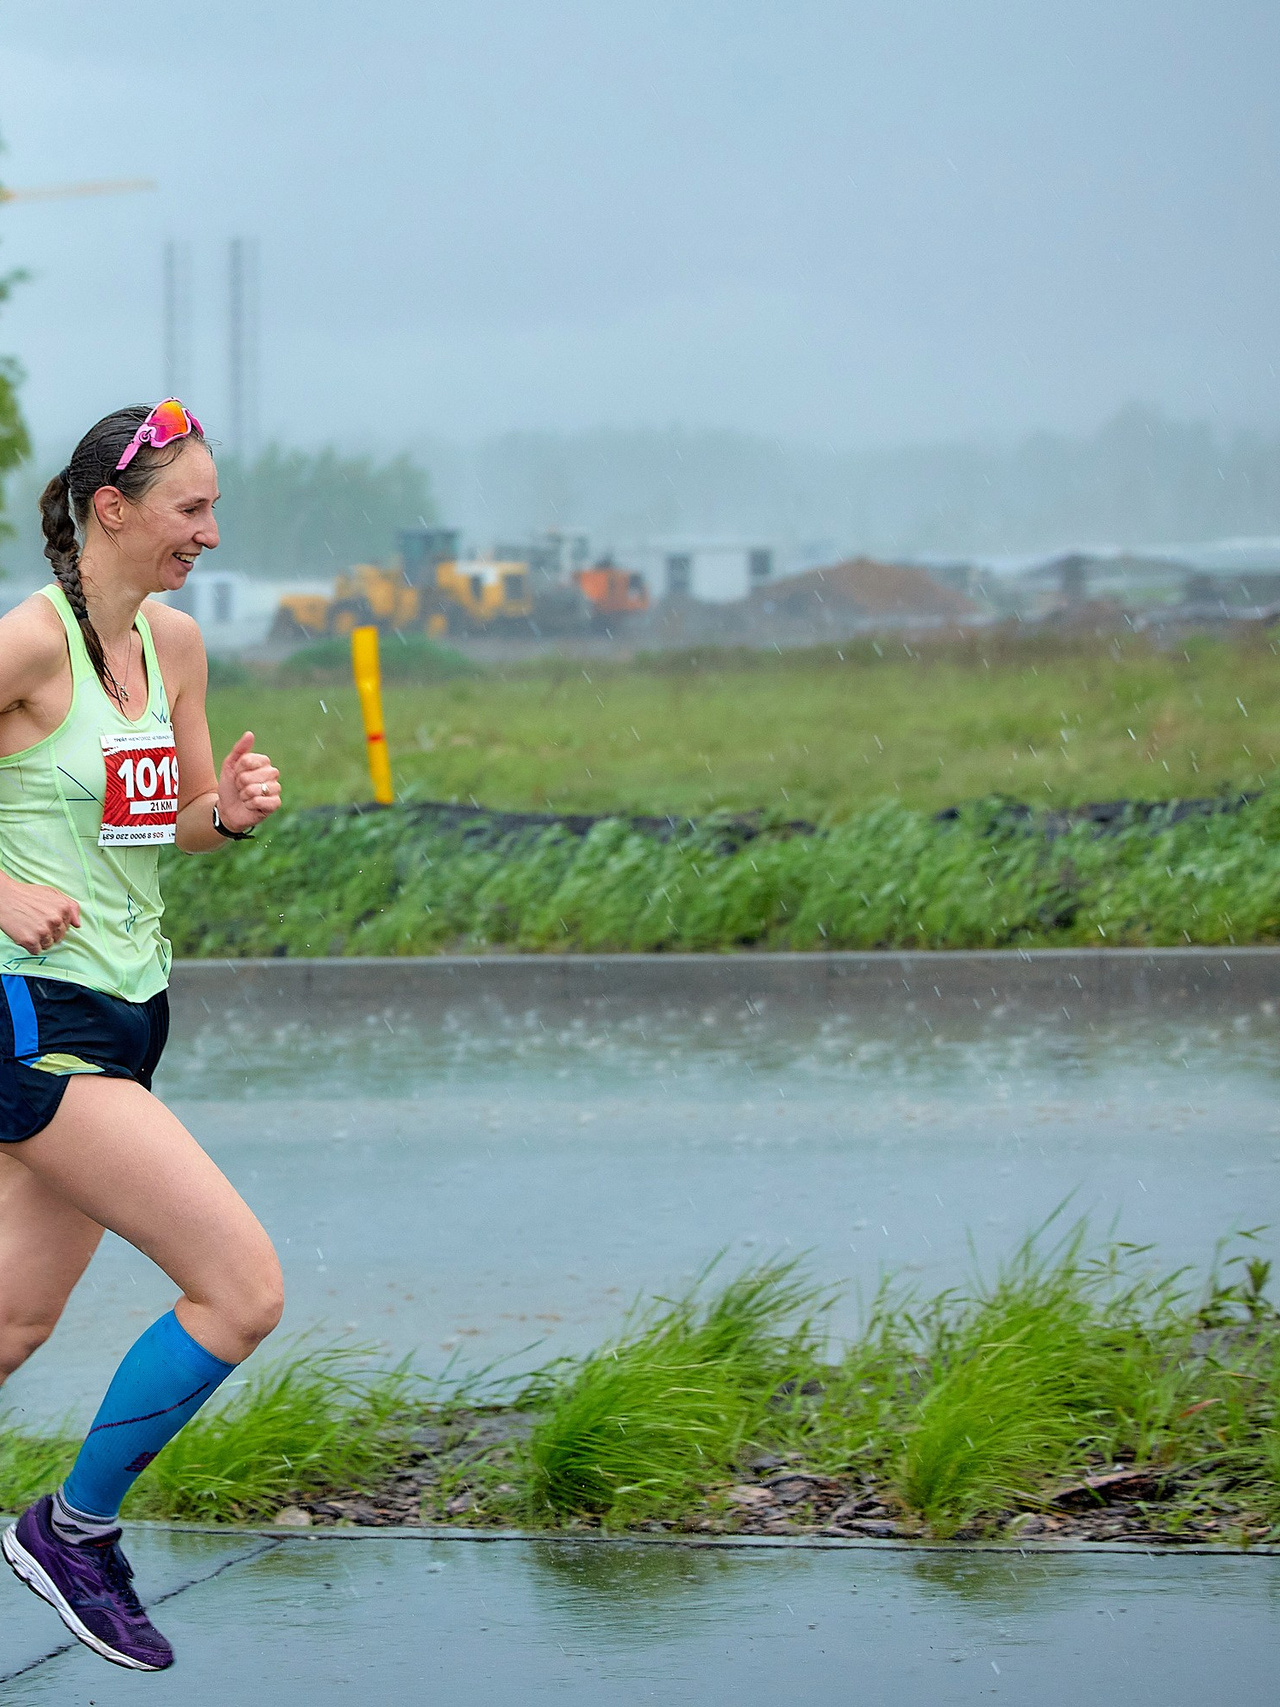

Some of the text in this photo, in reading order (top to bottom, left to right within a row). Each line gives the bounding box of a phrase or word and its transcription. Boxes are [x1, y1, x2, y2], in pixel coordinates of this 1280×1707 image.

[117, 756, 179, 798] 1019
[150, 800, 173, 812] 21 KM
